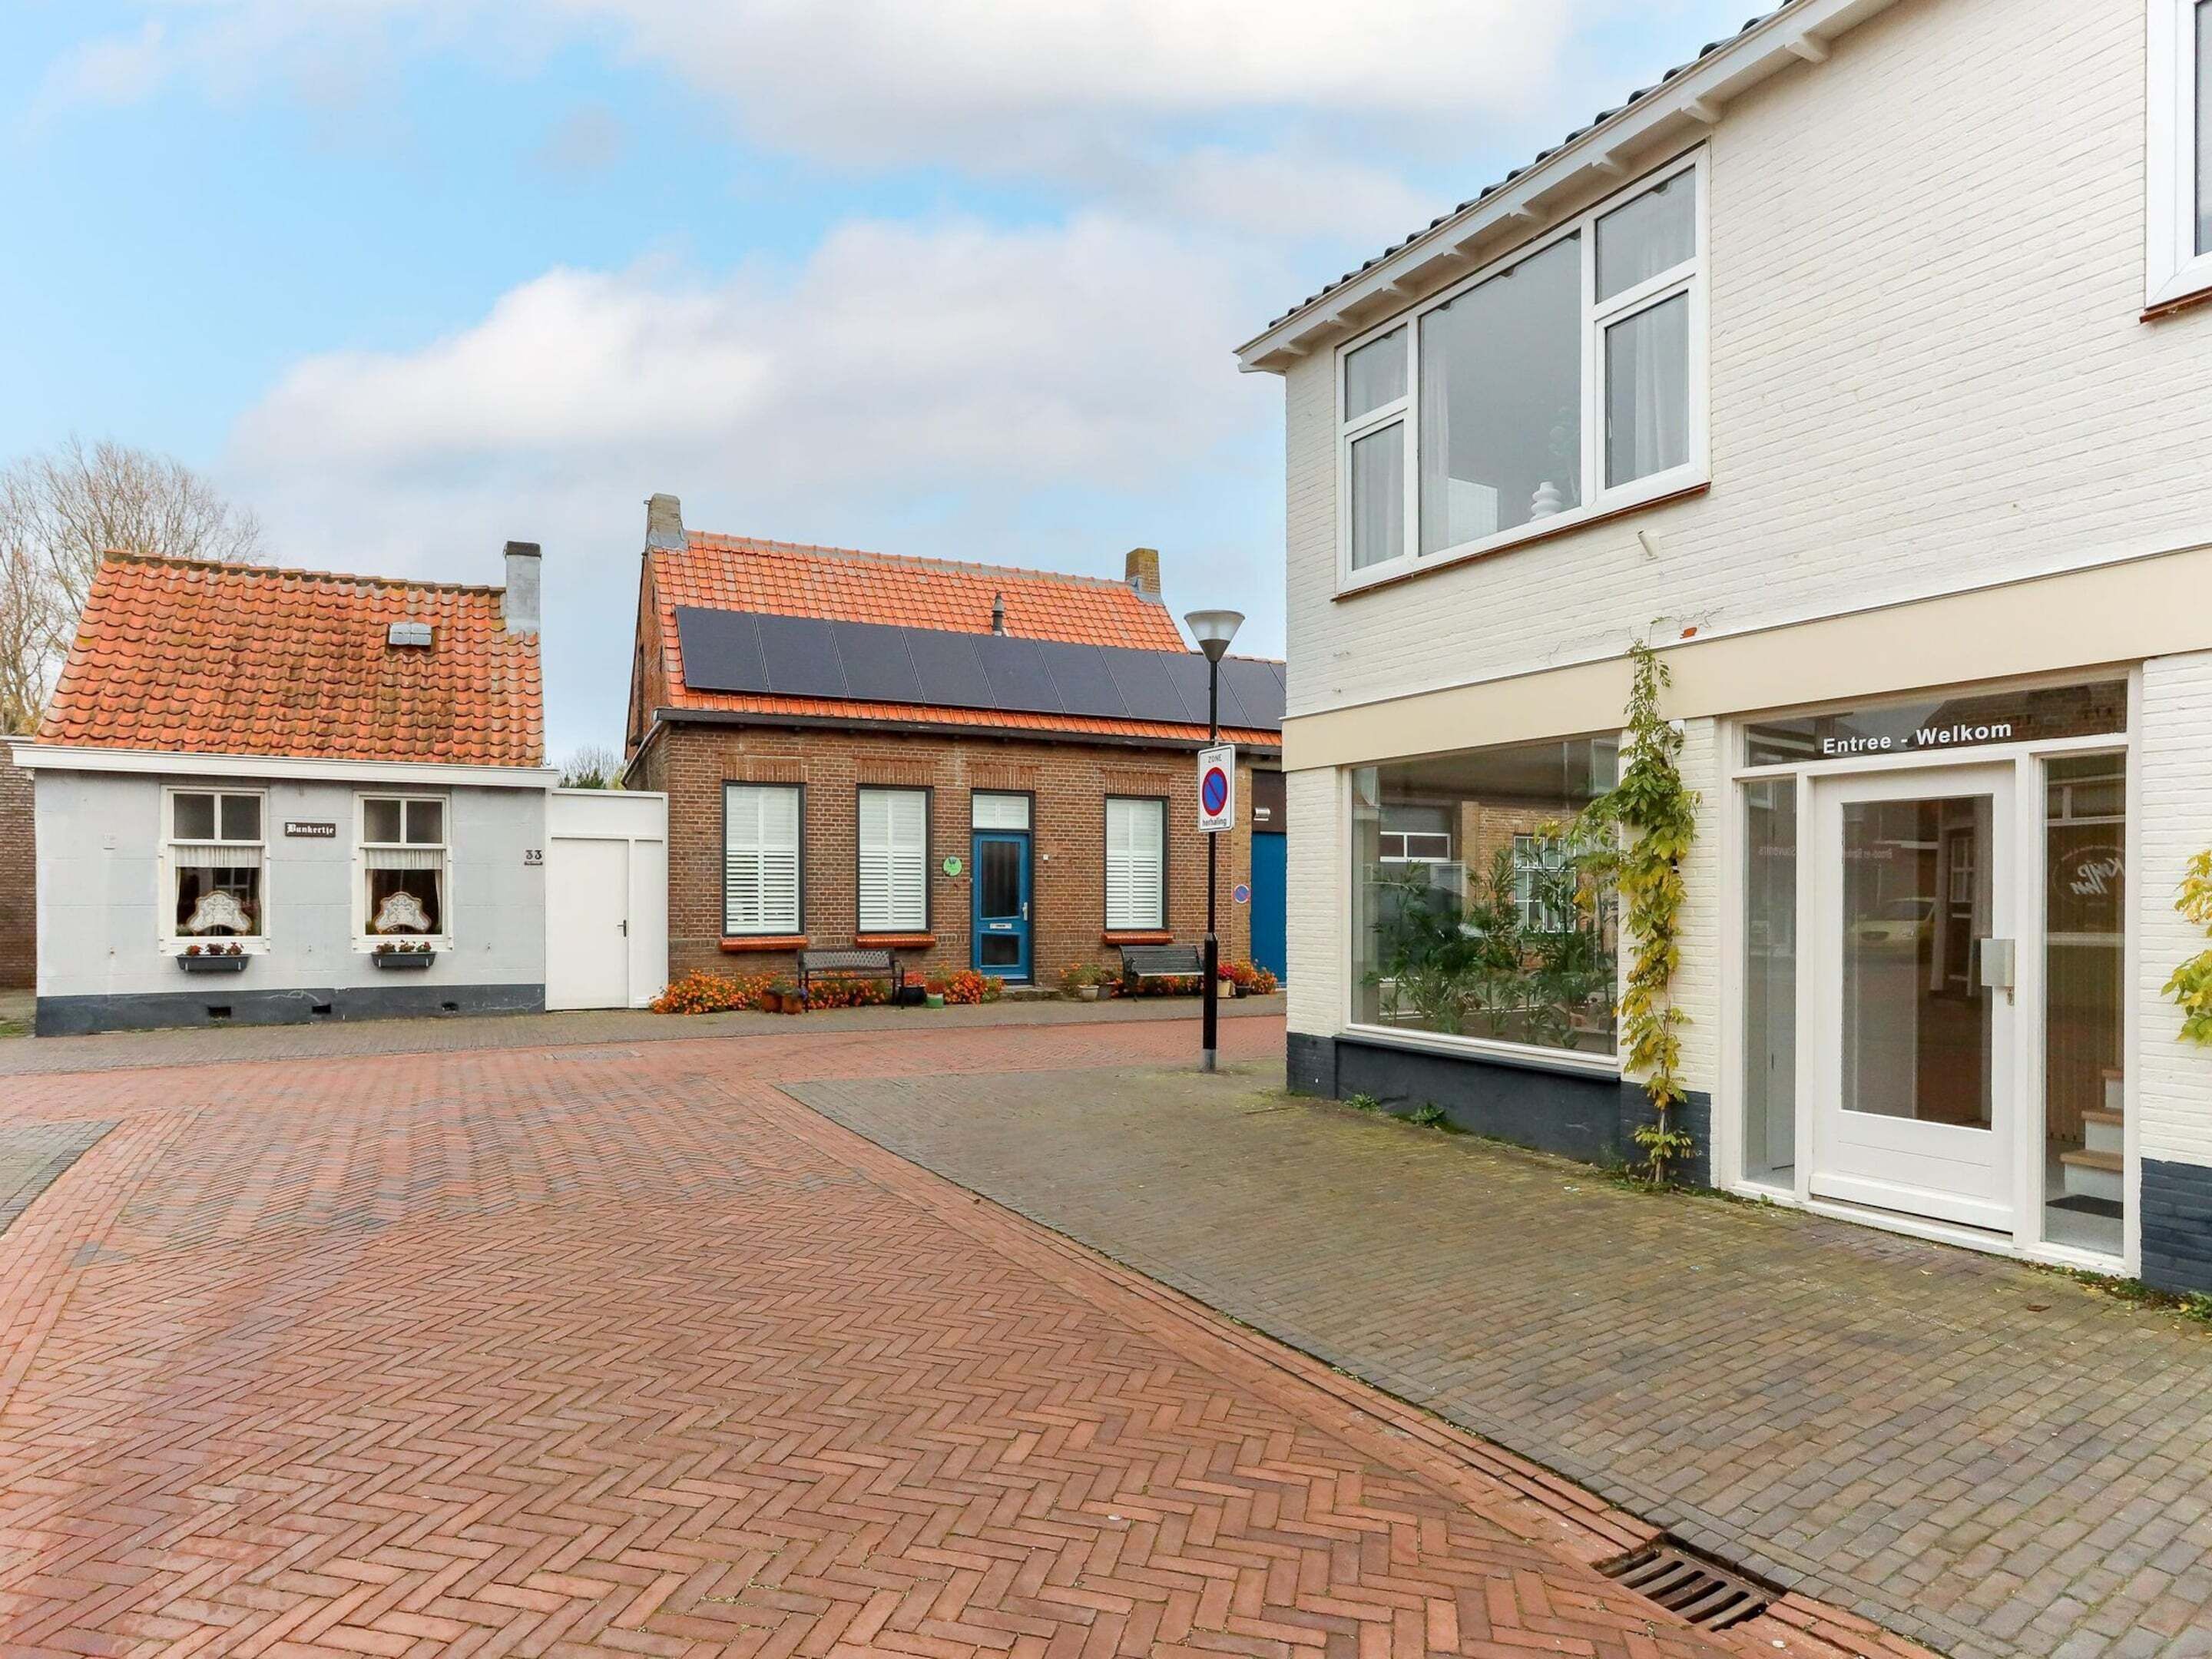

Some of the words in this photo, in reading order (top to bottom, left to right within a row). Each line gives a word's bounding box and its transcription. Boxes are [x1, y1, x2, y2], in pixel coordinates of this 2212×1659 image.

[1823, 736, 1892, 754] Entree
[1916, 724, 2012, 746] Welkom
[1207, 753, 1222, 763] ZONE
[1202, 817, 1227, 827] herhaling
[525, 849, 542, 860] 33
